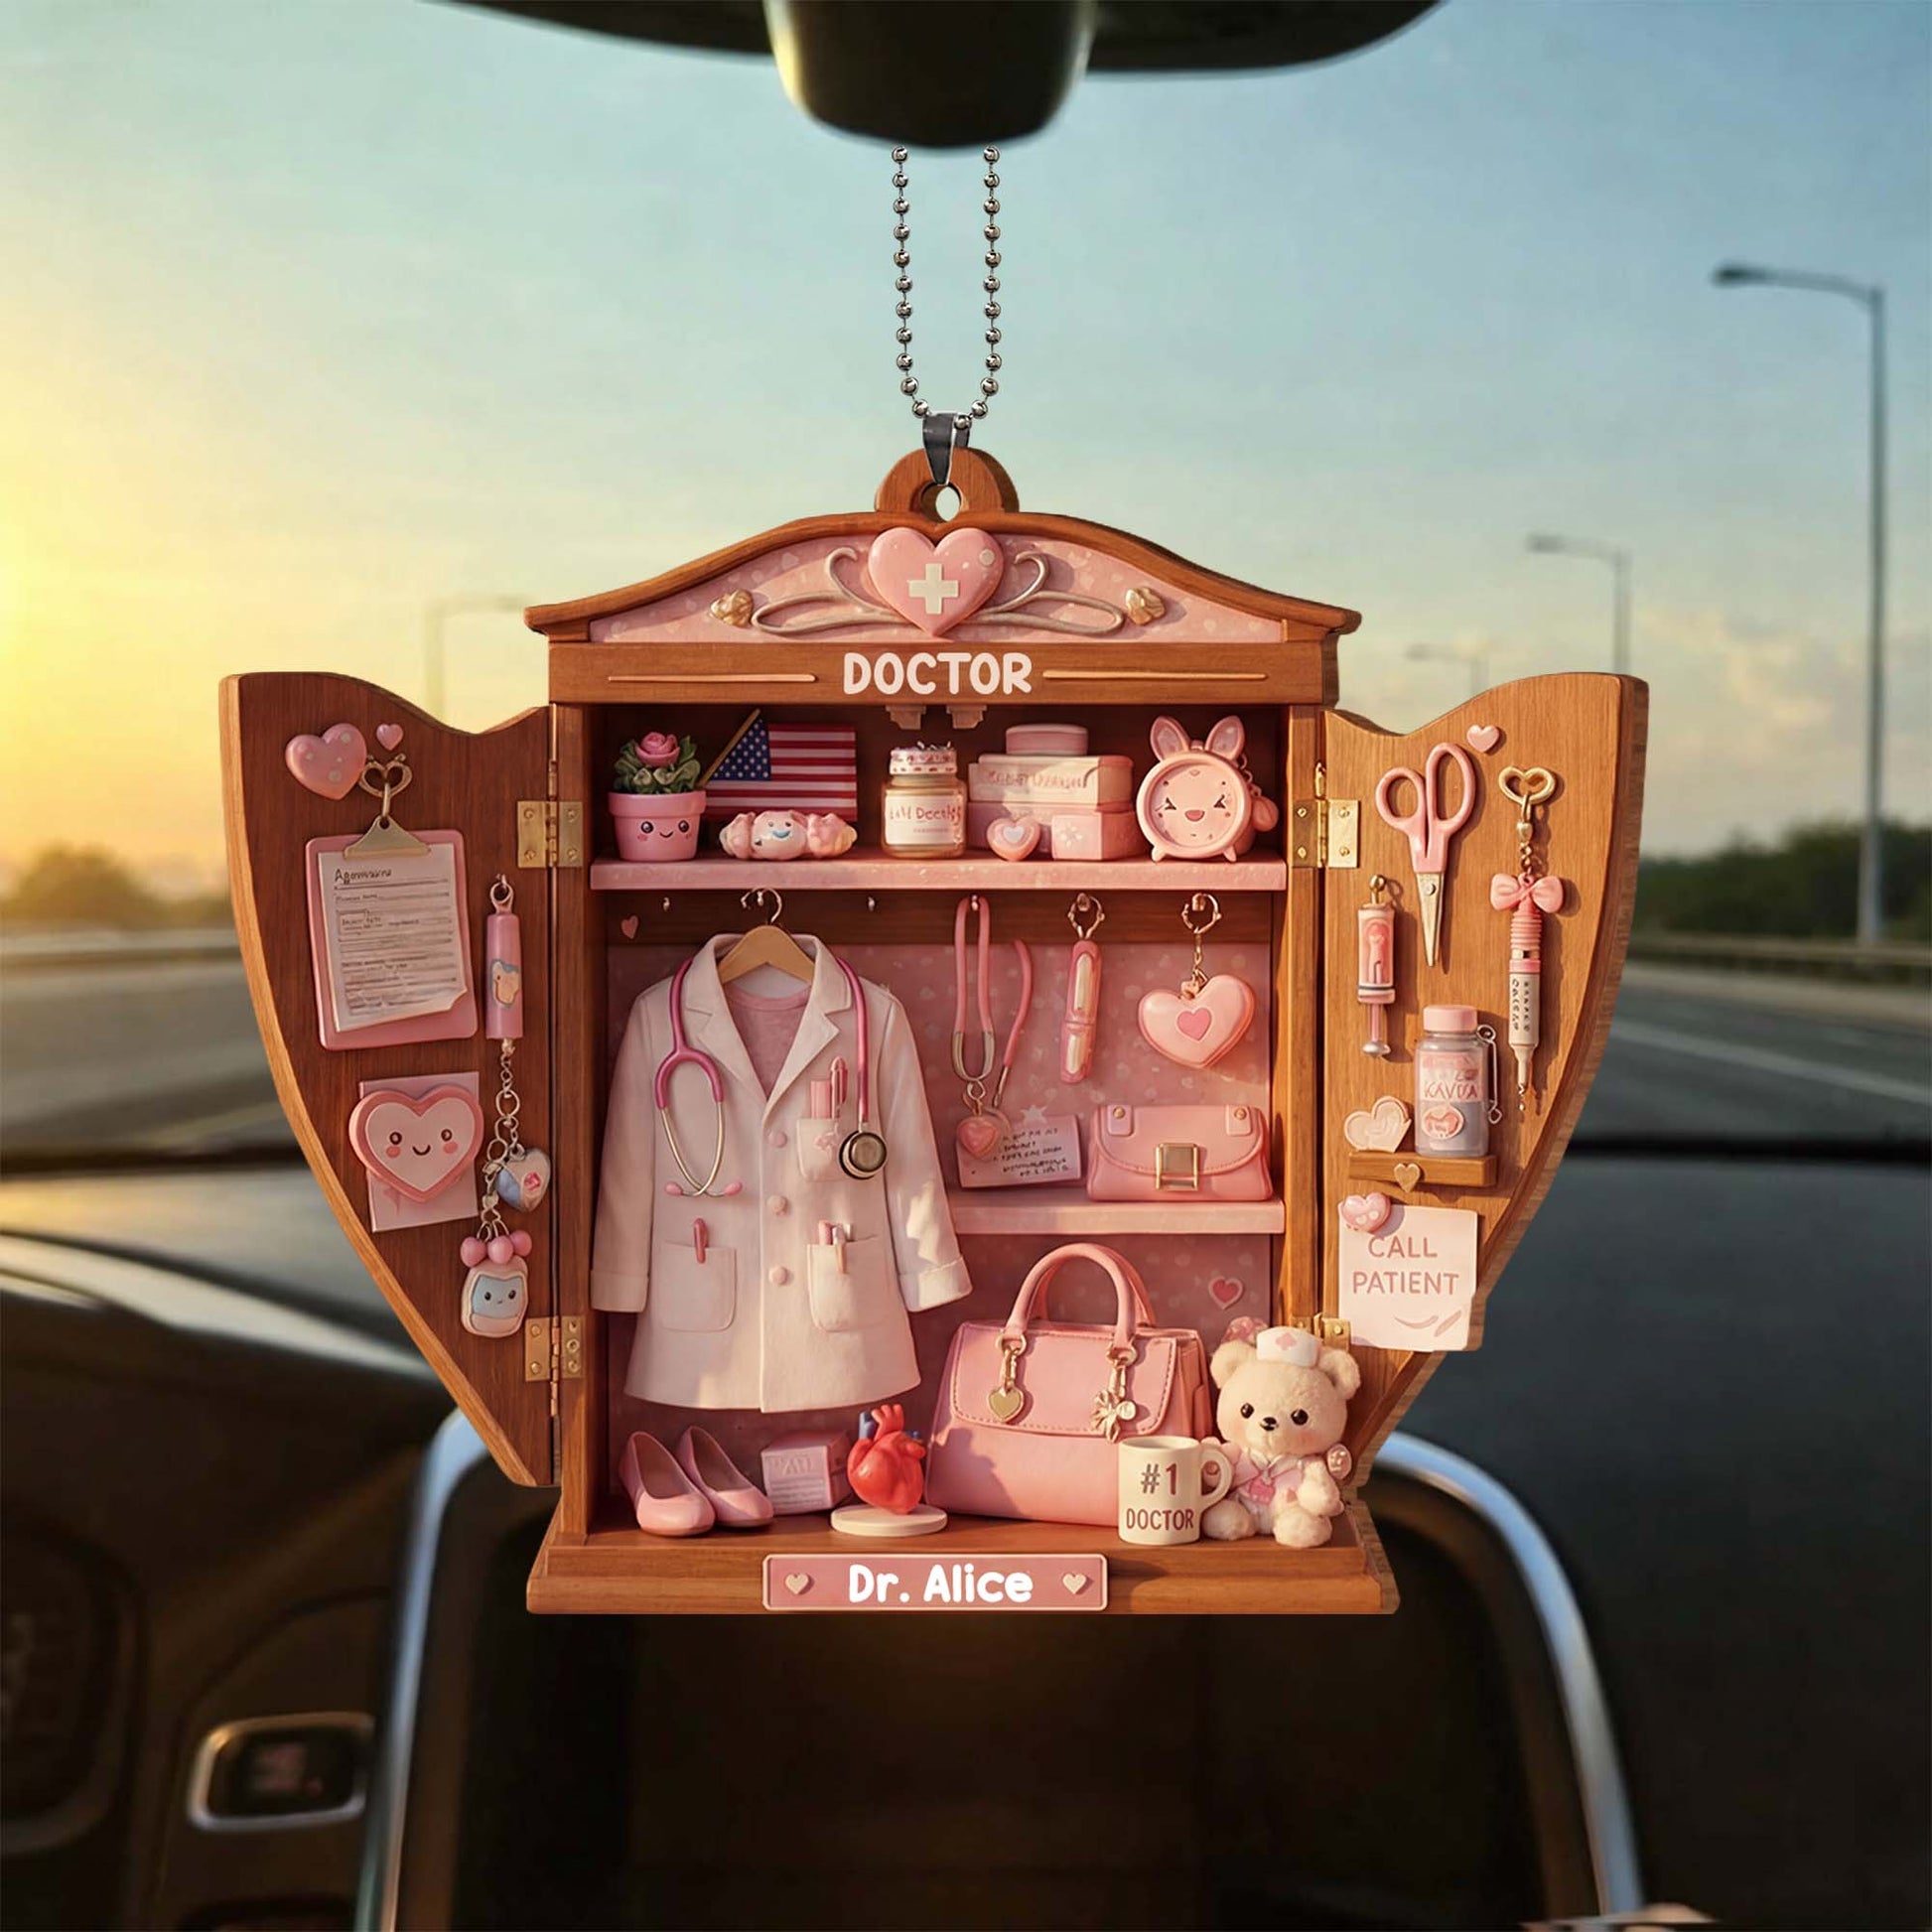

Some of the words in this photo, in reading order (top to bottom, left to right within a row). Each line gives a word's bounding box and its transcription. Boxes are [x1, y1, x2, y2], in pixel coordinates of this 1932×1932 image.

[844, 652, 1033, 695] DOCTOR
[1368, 1236, 1438, 1259] CALL
[1352, 1271, 1459, 1296] PATIENT
[1141, 1462, 1177, 1496] #1
[1126, 1508, 1194, 1531] DOCTOR
[849, 1564, 910, 1603] Dr.
[923, 1563, 1034, 1603] Alice
